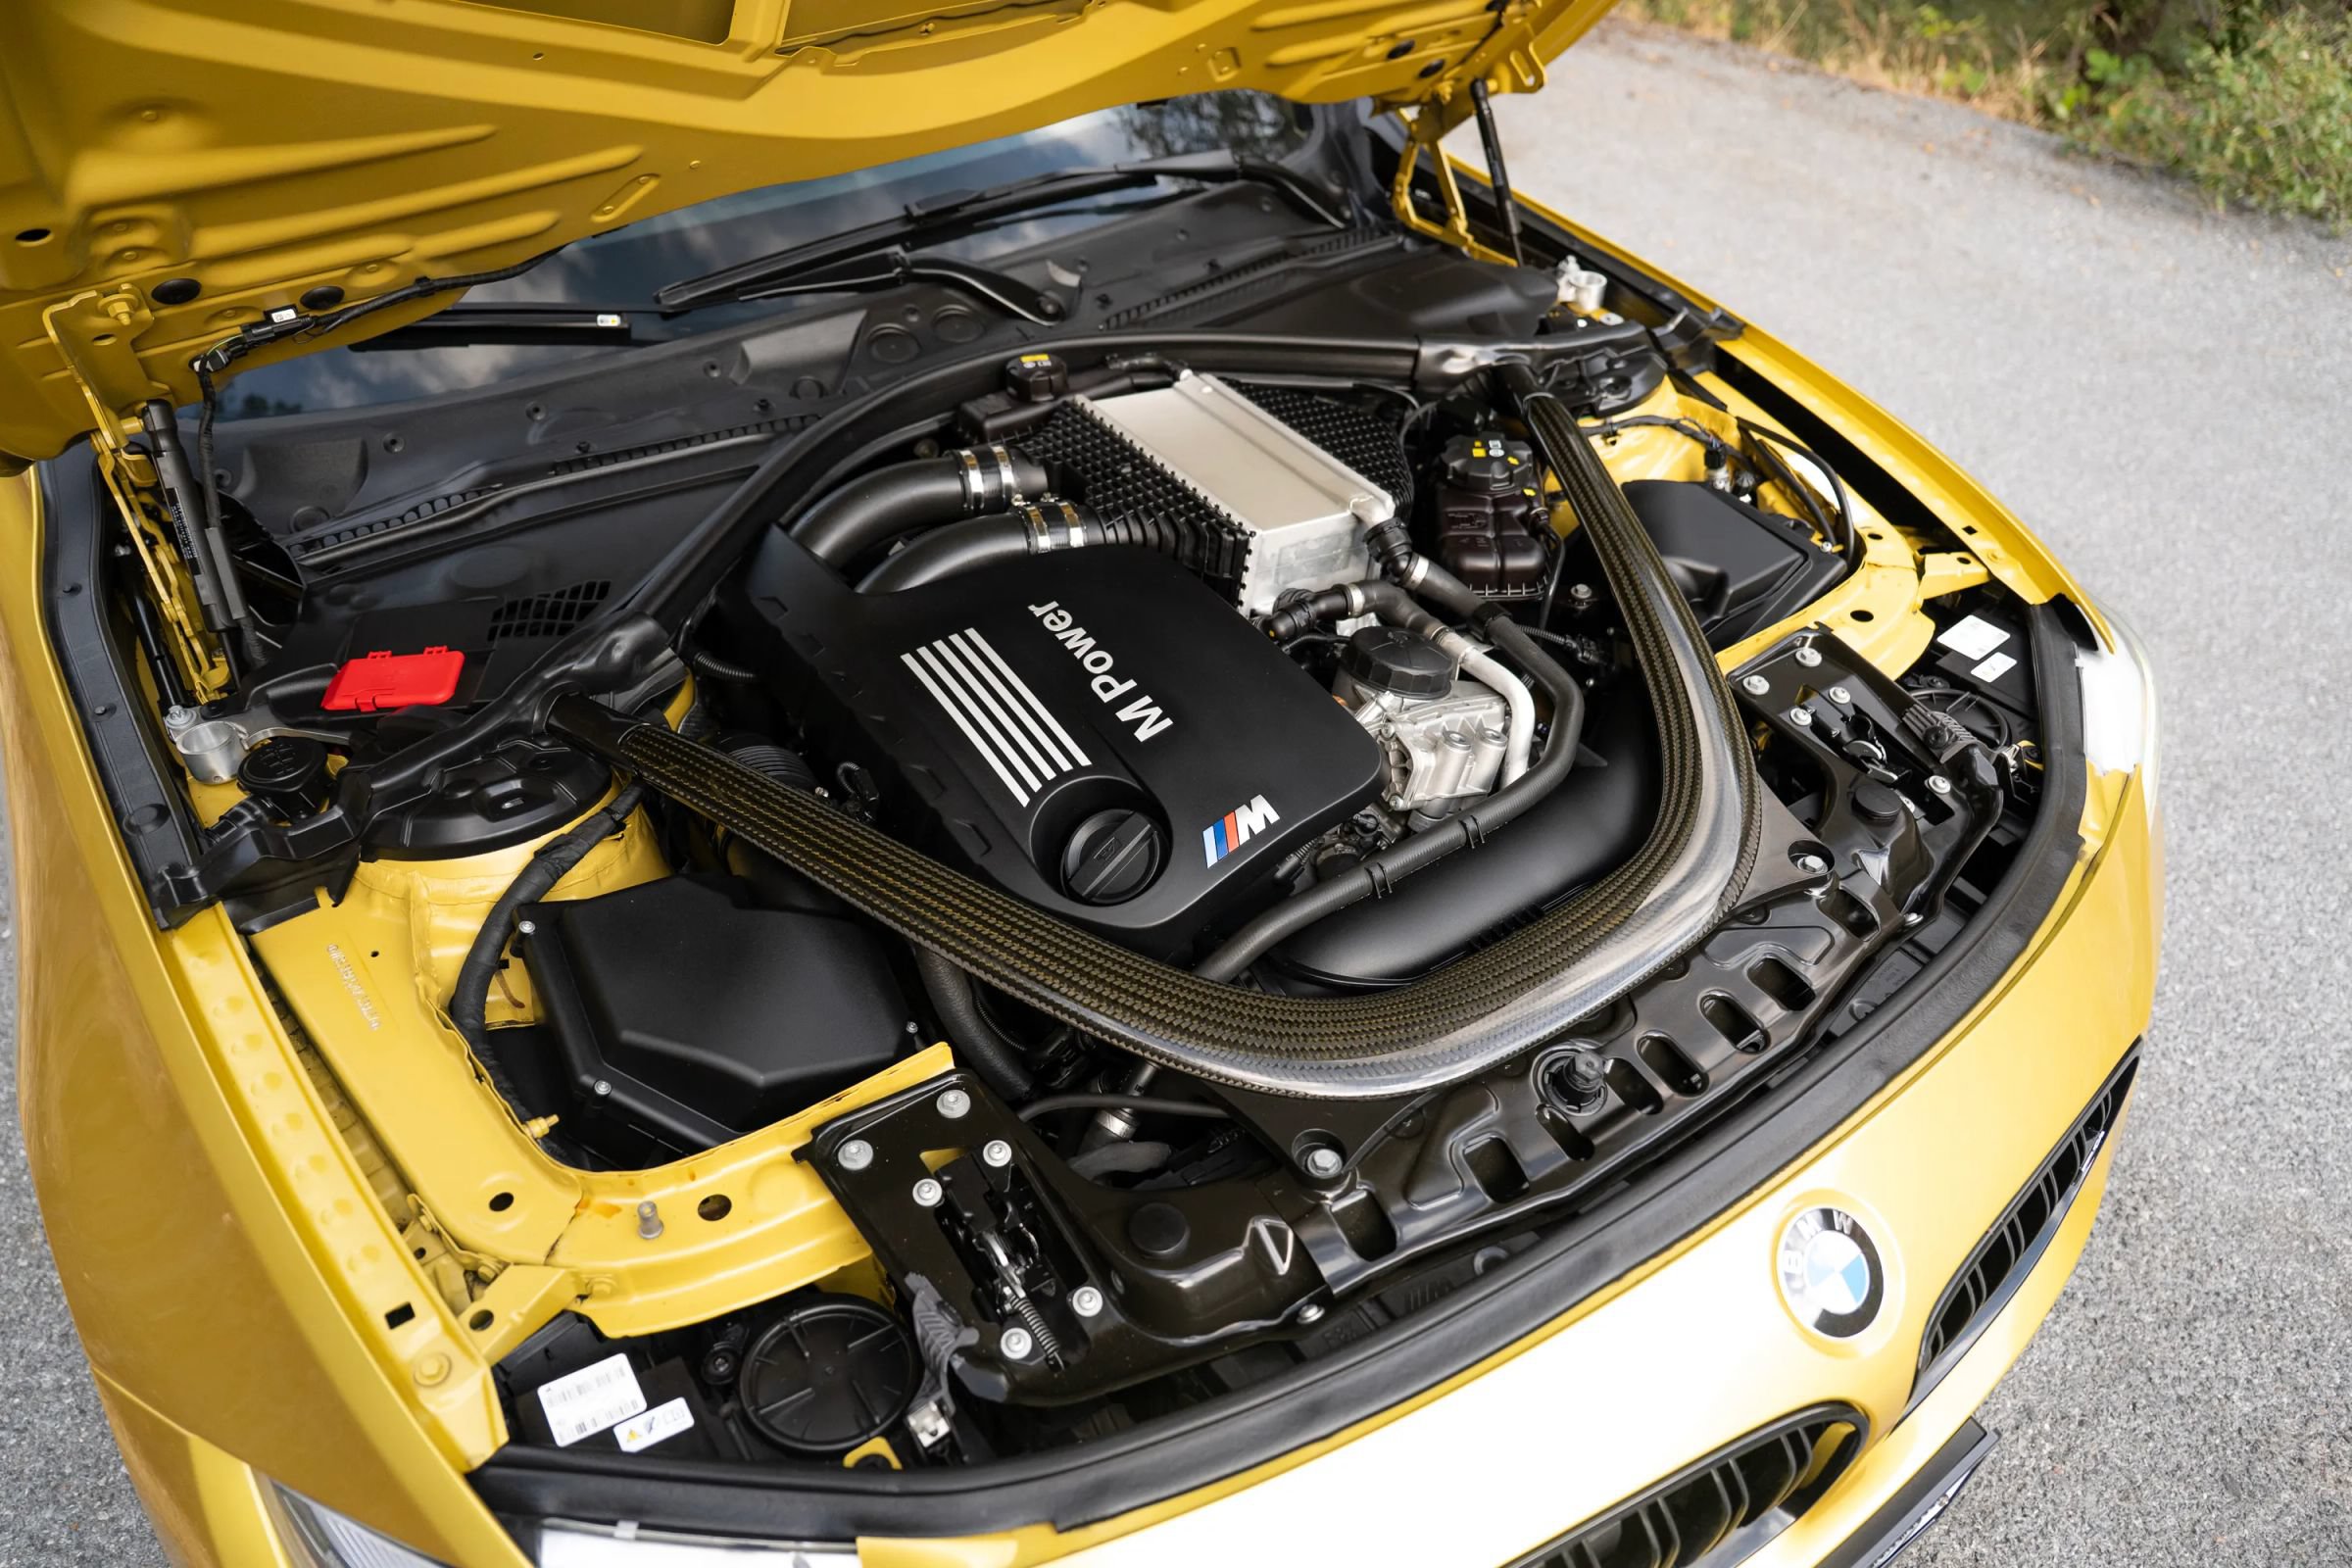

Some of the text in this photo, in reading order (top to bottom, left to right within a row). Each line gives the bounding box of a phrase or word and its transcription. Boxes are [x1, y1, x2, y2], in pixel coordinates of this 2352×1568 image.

[1027, 601, 1174, 743] M Power
[1784, 1208, 1854, 1274] BMW
